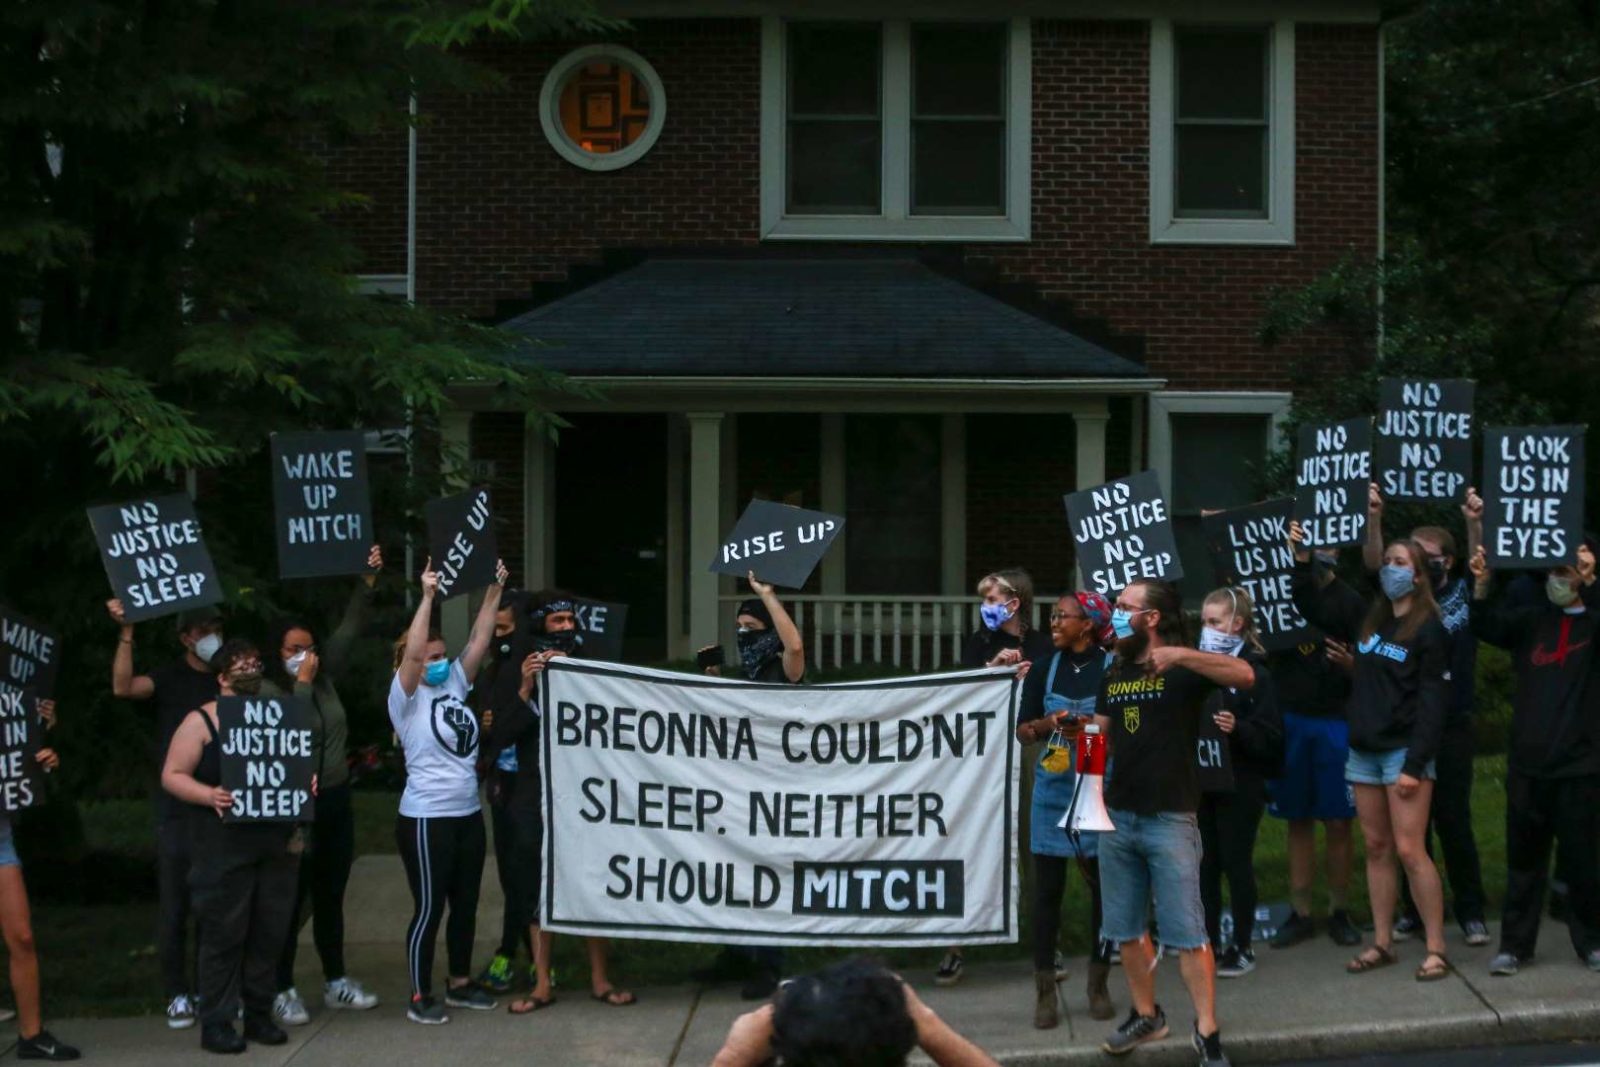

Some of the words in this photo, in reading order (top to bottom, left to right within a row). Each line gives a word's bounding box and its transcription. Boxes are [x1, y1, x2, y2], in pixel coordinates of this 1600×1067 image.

[1402, 382, 1441, 407] NO
[1378, 409, 1471, 439] JUSTICE
[1316, 425, 1347, 453] NO
[1500, 434, 1570, 463] LOOK
[282, 450, 353, 479] WAKE
[1297, 451, 1370, 486] JUSTICE
[1400, 442, 1441, 468] NO
[1383, 469, 1465, 498] SLEEP
[1500, 465, 1535, 493] US
[1542, 467, 1569, 493] IN
[303, 484, 337, 510] UP
[1092, 482, 1131, 511] NO
[1314, 487, 1347, 515] NO
[121, 502, 159, 528] NO
[1075, 498, 1168, 544] JUSTICE
[1500, 498, 1560, 525] THE
[107, 519, 199, 558] JUSTICE
[288, 513, 362, 544] MITCH
[436, 532, 474, 596] RISE
[466, 490, 490, 531] UP
[723, 530, 785, 564] RISE
[797, 520, 835, 544] UP
[1228, 515, 1290, 547] LOOK
[1302, 512, 1365, 547] SLEEP
[1496, 527, 1567, 559] EYES
[1103, 535, 1145, 565] NO
[1235, 548, 1267, 576] US
[1272, 545, 1296, 570] IN
[136, 553, 178, 581] NO
[127, 572, 206, 609] SLEEP
[1240, 574, 1293, 604] THE
[2, 617, 54, 664] WAKE
[9, 656, 35, 681] UP
[1107, 678, 1165, 697] SUNRISE
[244, 701, 283, 725] NO
[5, 719, 27, 746] IN
[222, 730, 312, 758] JUSTICE
[556, 701, 758, 761] BREONNA
[781, 711, 996, 765] COULD'NT
[246, 761, 286, 788] NO
[231, 789, 308, 818] SLEEP
[579, 777, 727, 835] SLEEP.
[749, 792, 948, 838] NEITHER
[605, 854, 782, 909] SHOULD
[802, 868, 946, 911] MITCH
